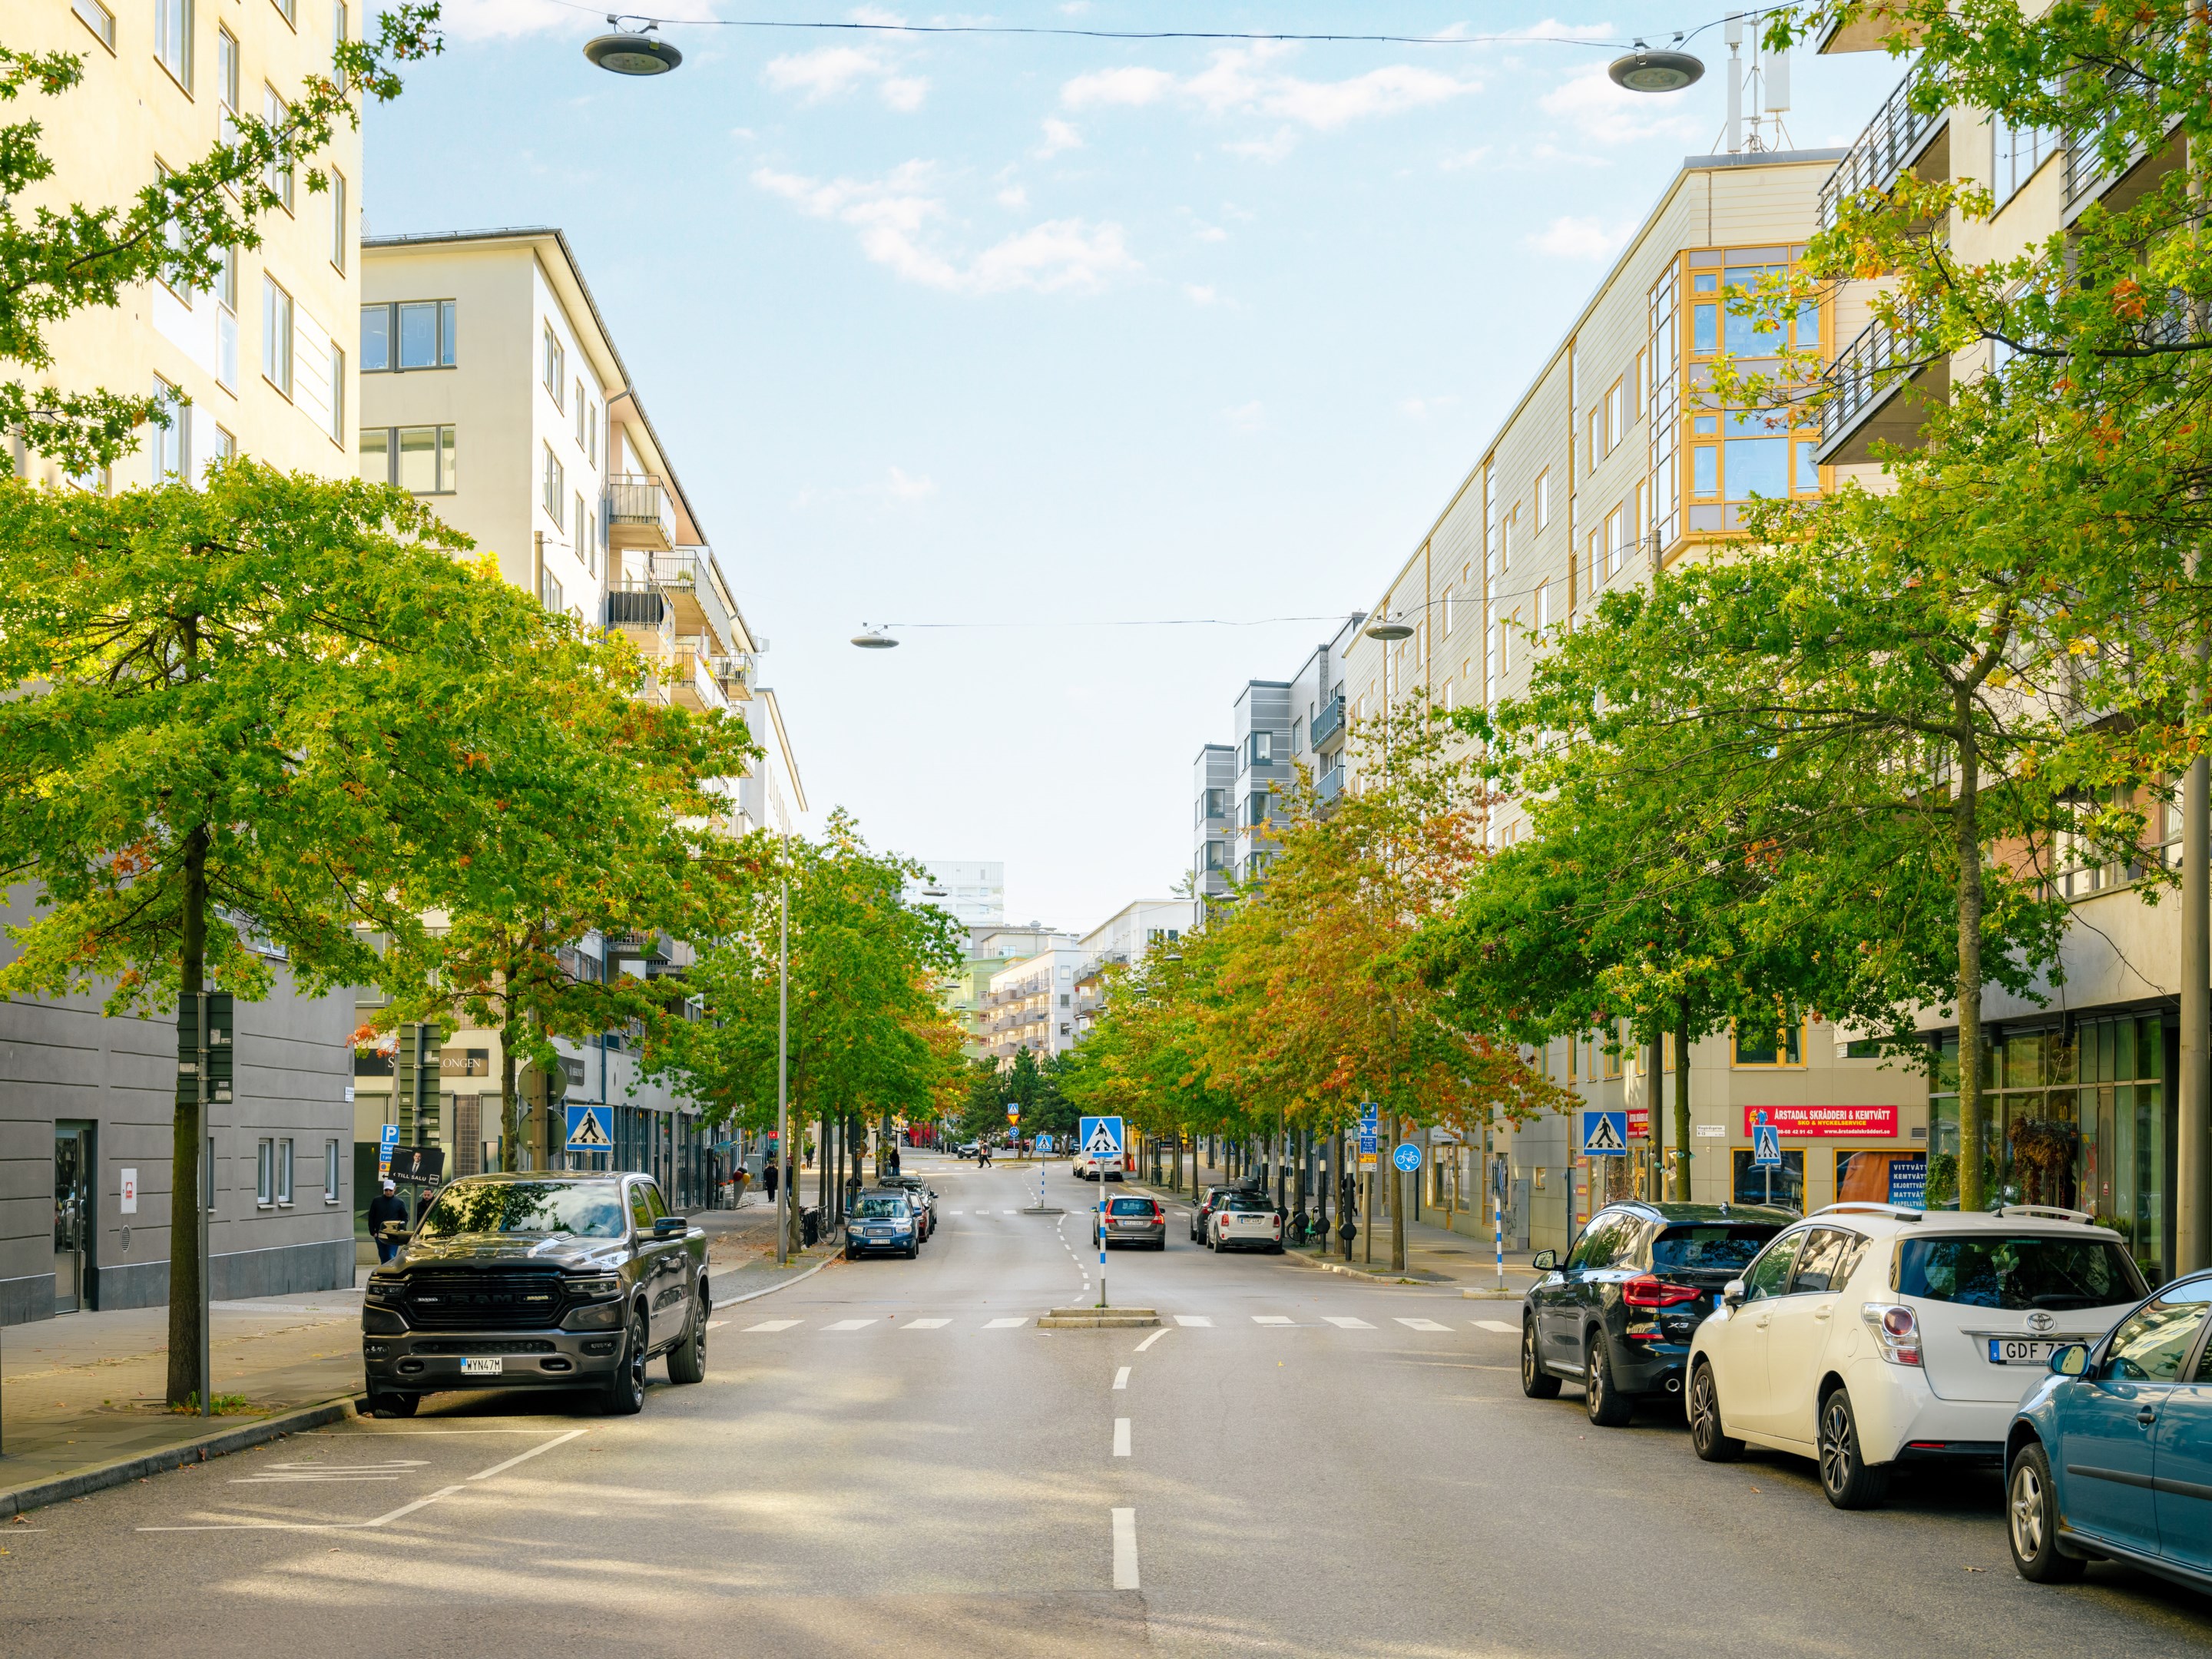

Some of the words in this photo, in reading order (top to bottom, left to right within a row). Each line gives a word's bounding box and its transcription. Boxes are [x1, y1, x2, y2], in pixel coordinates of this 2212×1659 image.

[439, 1058, 481, 1068] ONGEN
[1774, 1108, 1808, 1120] ÅRSTADAL
[1810, 1108, 1847, 1120] SKRÄDDERI
[1849, 1110, 1853, 1120] &
[1855, 1108, 1890, 1120] KEMTVÄTT
[386, 1126, 397, 1141] P
[450, 1294, 514, 1303] RAM
[2006, 1343, 2038, 1358] GDF
[2045, 1343, 2066, 1358] 7
[467, 1359, 500, 1370] WYN47M
